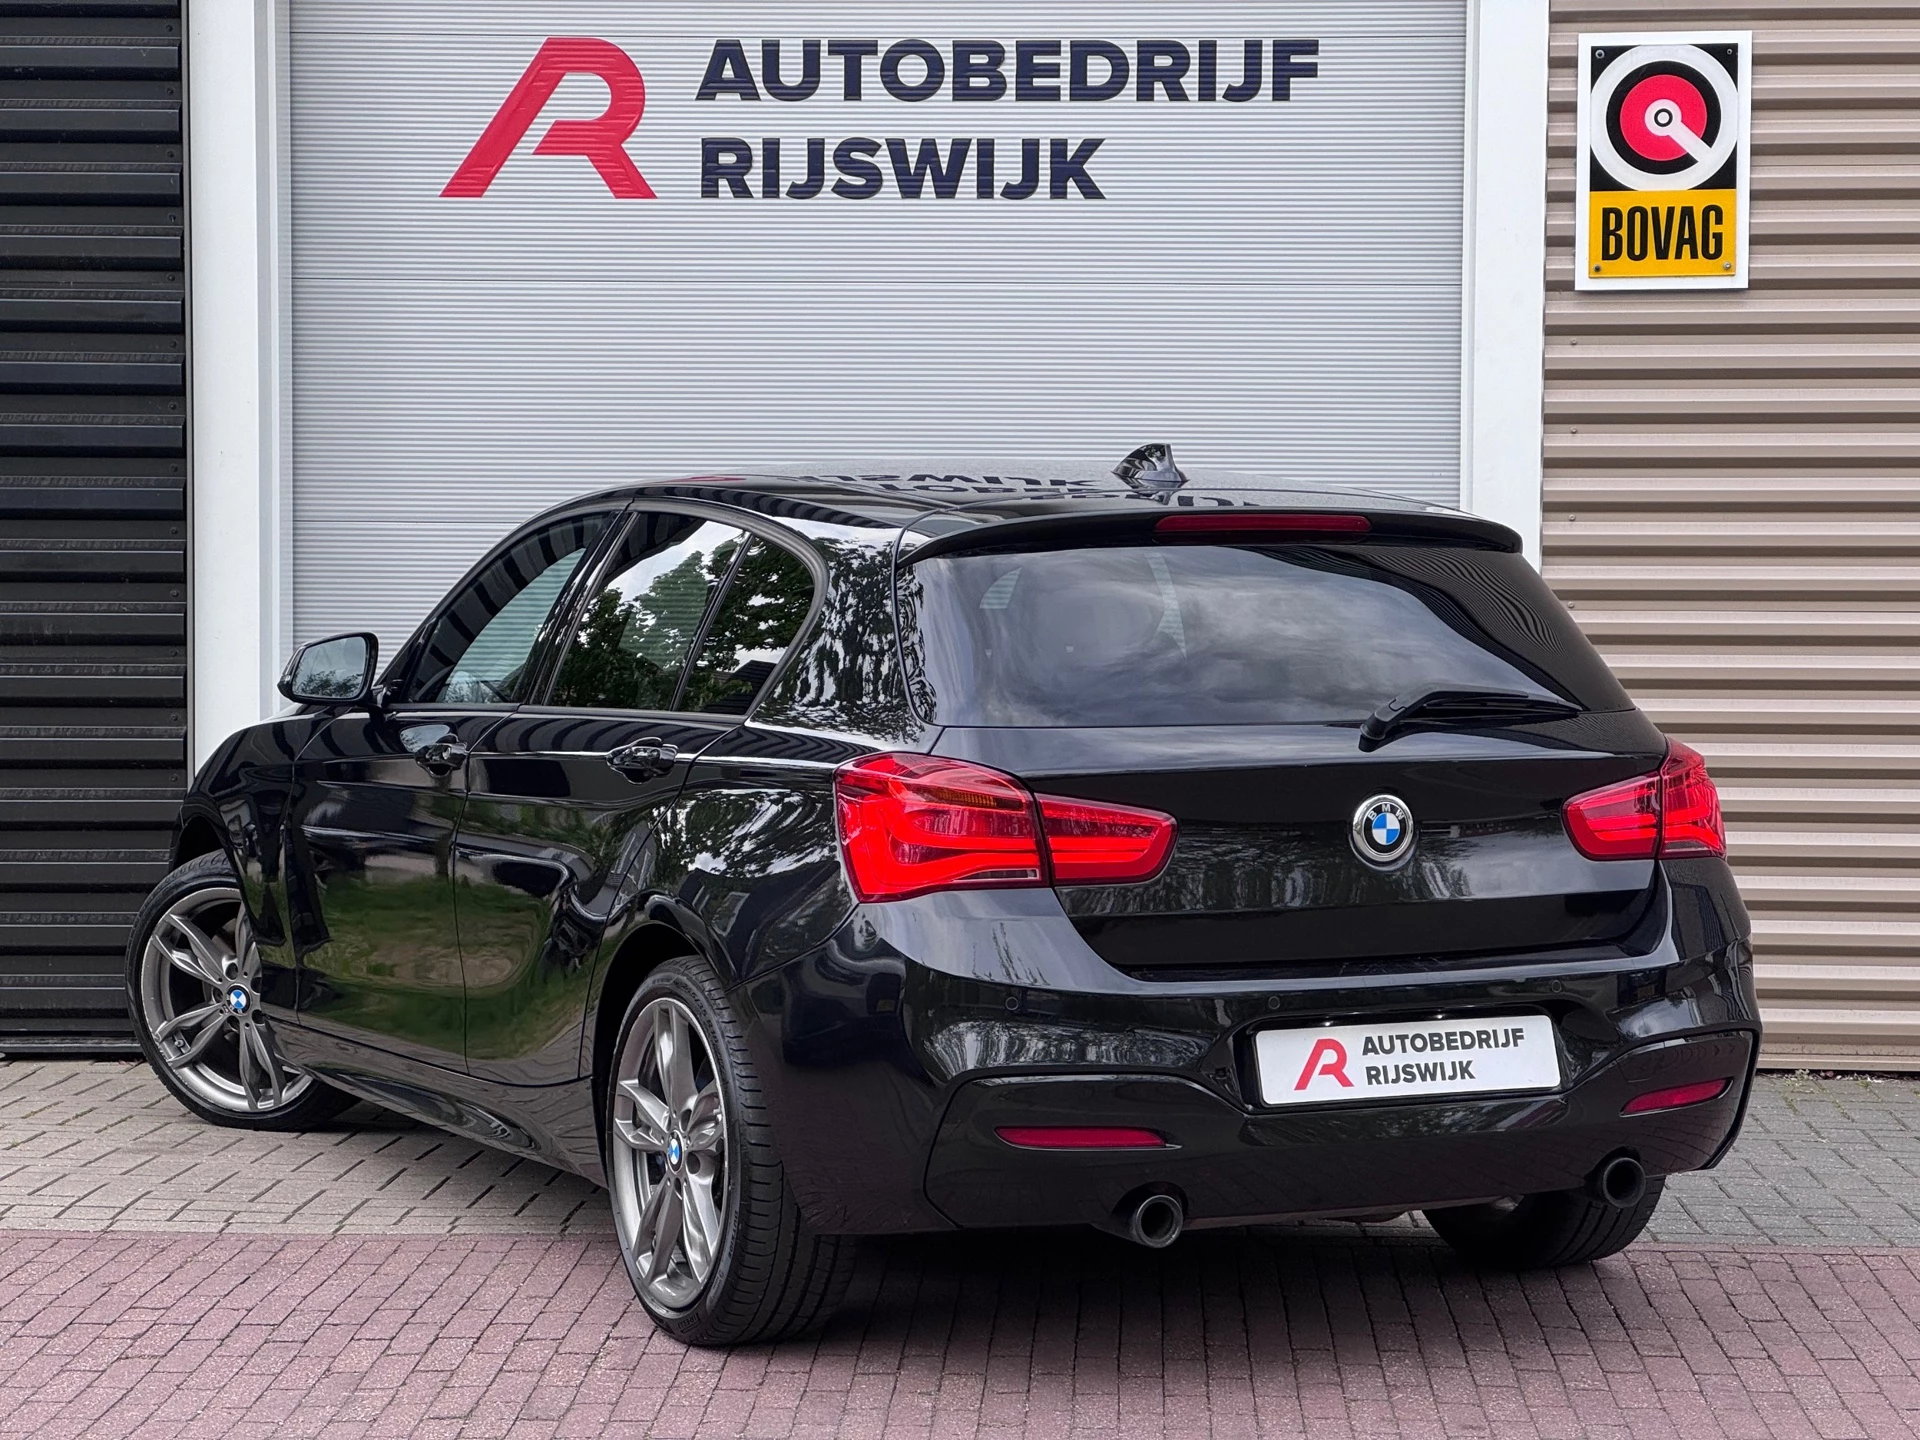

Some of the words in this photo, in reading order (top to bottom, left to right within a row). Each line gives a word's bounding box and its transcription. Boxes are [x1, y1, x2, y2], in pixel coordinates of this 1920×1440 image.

[695, 38, 1320, 102] AUTOBEDRIJF
[701, 137, 1105, 199] RIJSWIJK
[1601, 203, 1724, 262] BOVAG
[1367, 803, 1405, 821] BMW
[1362, 1028, 1525, 1056] AUTOBEDRIJF
[1365, 1060, 1476, 1086] RIJSWIJK
